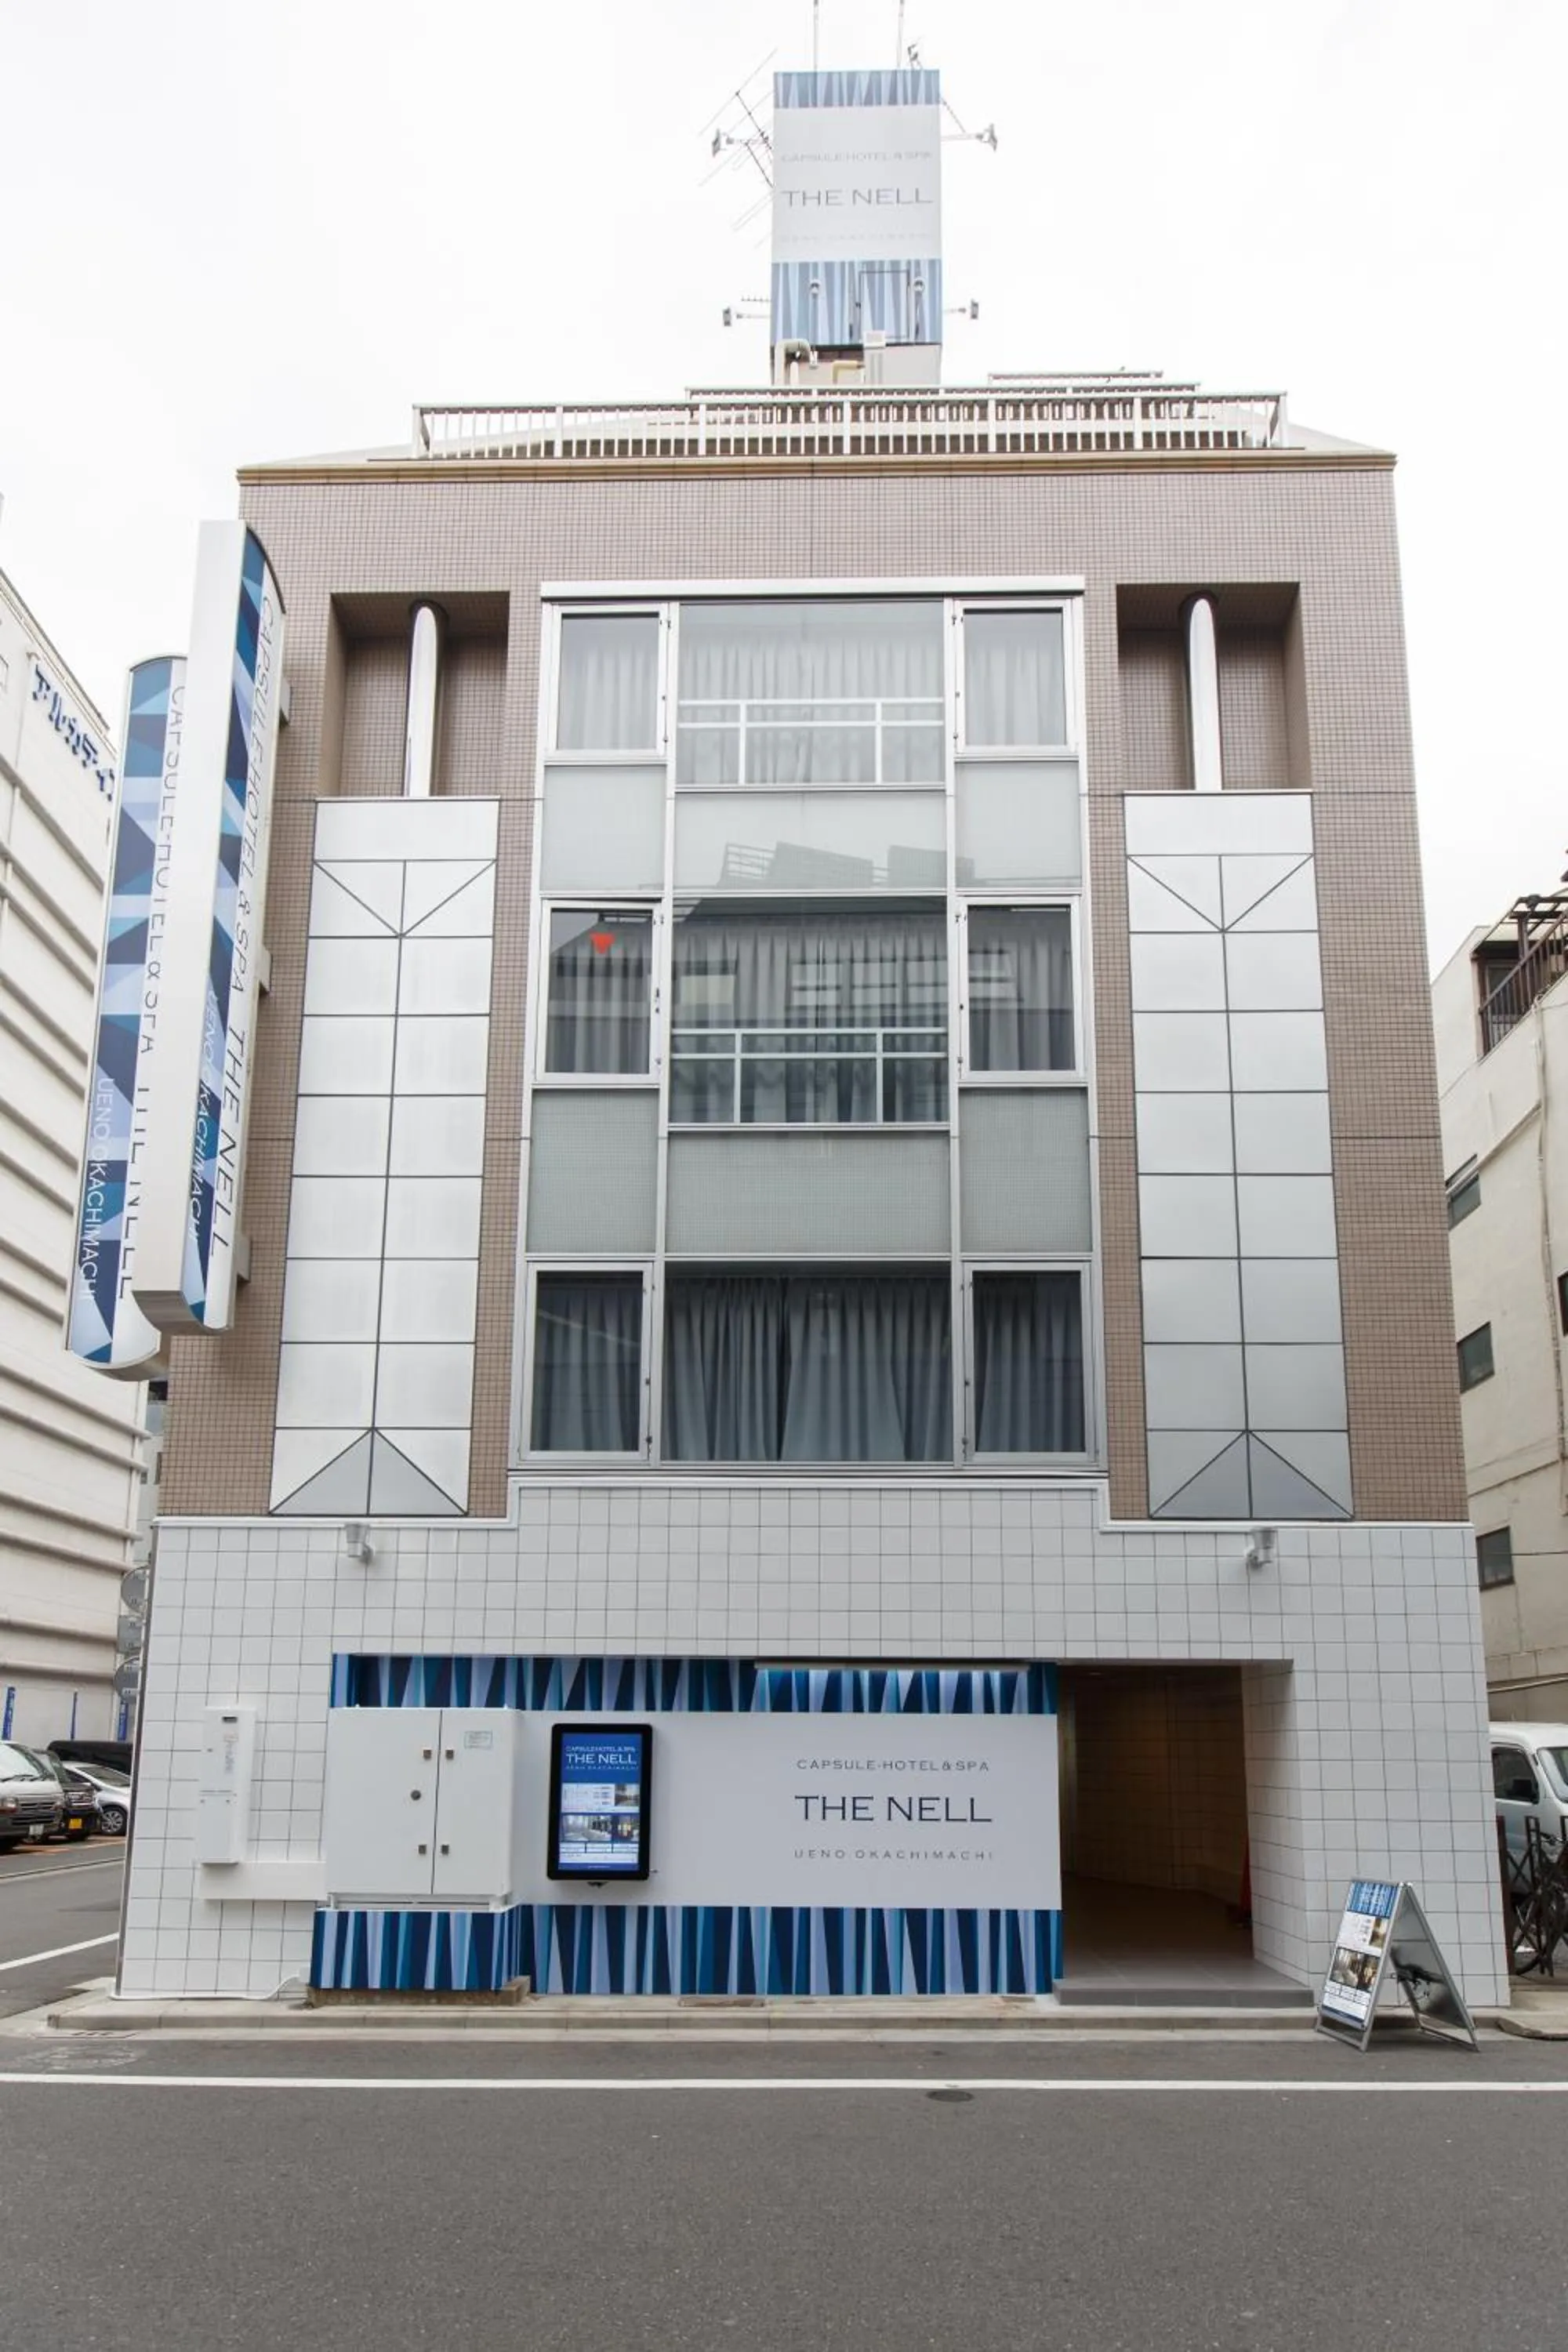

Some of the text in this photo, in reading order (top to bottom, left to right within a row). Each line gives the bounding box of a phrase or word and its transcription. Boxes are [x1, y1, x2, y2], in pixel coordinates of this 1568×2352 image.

[781, 187, 934, 207] THE NELL
[222, 1026, 245, 1123] THE
[78, 1077, 115, 1300] UENO OKACHIMACHI
[211, 1128, 236, 1256] NELL
[565, 1754, 637, 1765] THE NELL
[794, 1795, 993, 1823] THE NELL
[794, 1849, 993, 1861] UENO OKACHIMACHI
